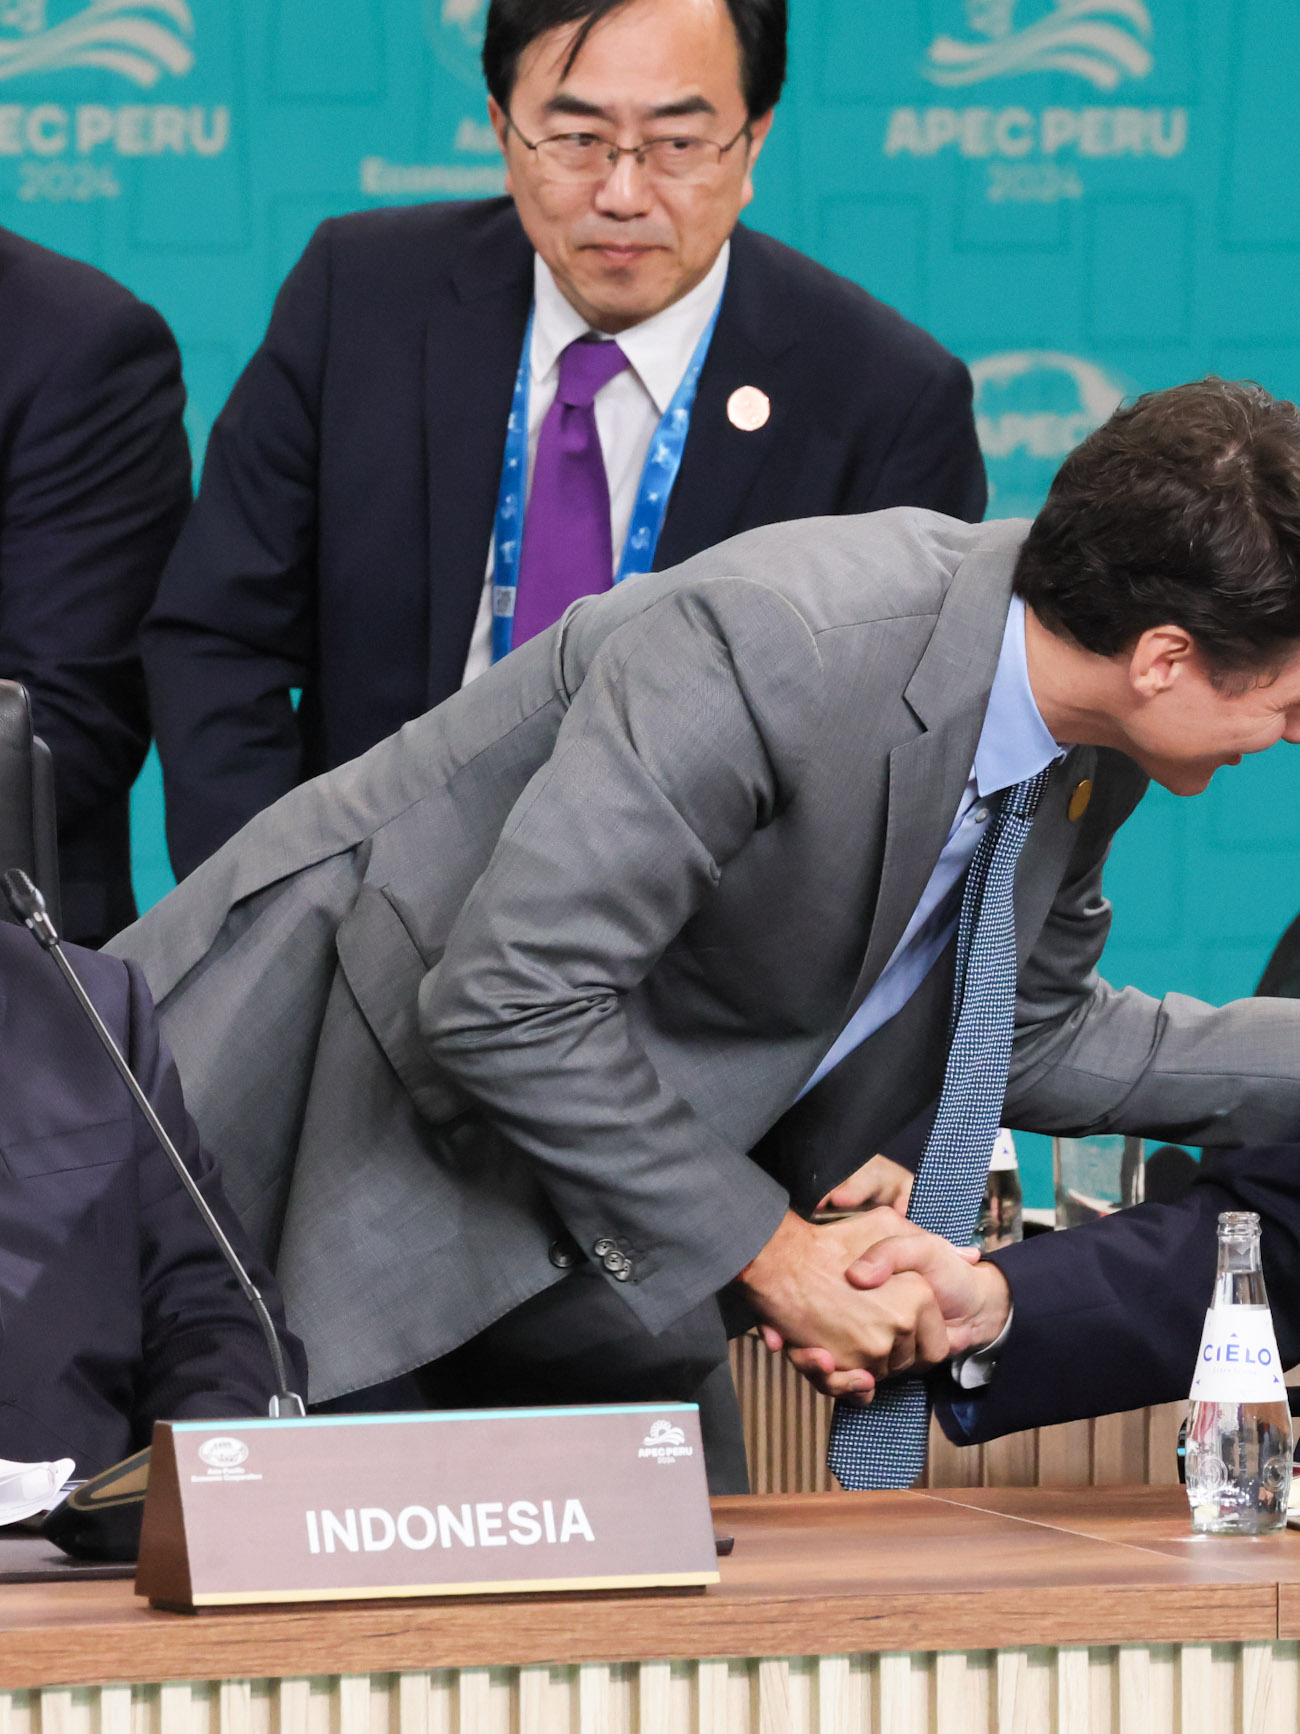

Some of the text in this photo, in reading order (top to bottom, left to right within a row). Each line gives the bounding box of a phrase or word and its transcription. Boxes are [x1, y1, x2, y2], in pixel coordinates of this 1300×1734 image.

[76, 104, 229, 156] PERU
[885, 106, 1187, 156] APEC PERU
[20, 163, 120, 200] 2024
[988, 163, 1083, 201] 2024
[1203, 1344, 1271, 1366] CIELO
[638, 1446, 693, 1458] APEC PERU
[306, 1499, 596, 1554] INDONESIA
